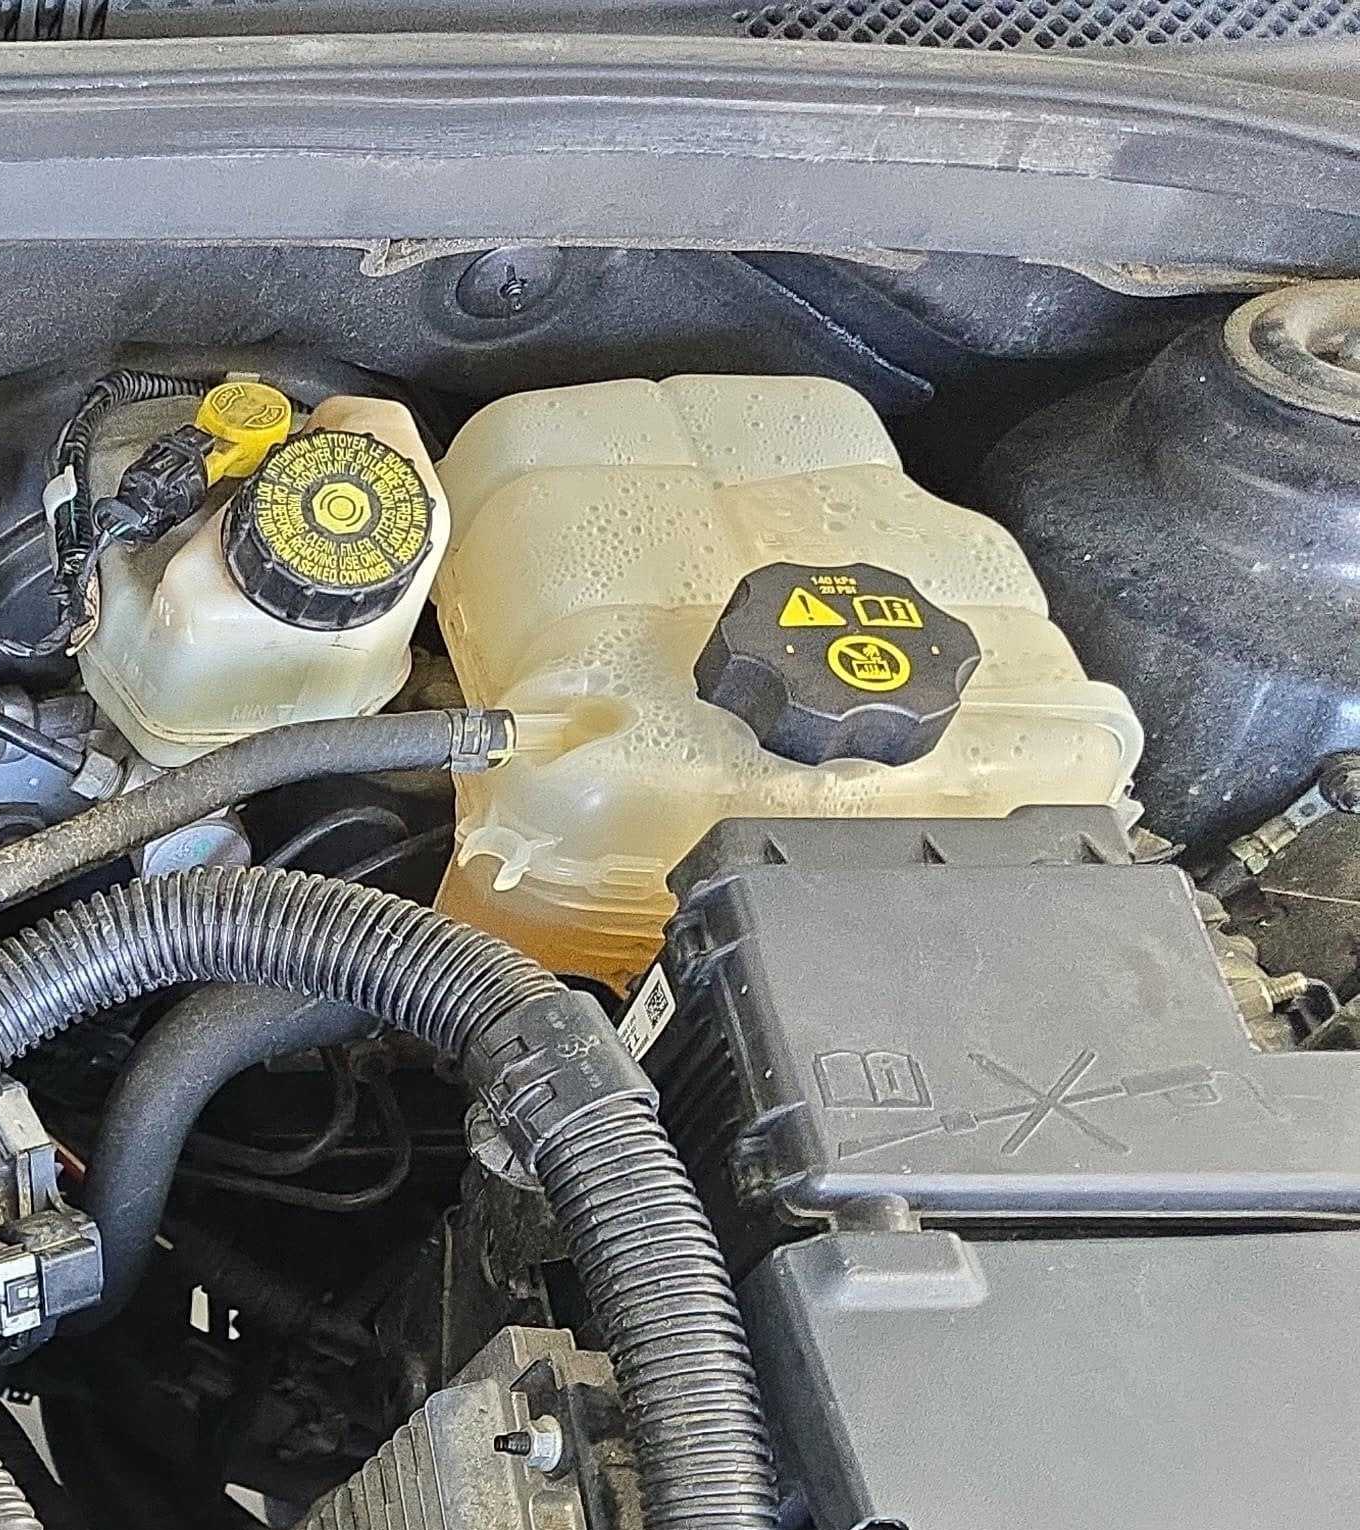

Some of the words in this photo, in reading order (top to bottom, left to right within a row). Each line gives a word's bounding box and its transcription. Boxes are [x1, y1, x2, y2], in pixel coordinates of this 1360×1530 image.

[285, 448, 332, 478] EMPLOYER
[334, 447, 354, 461] QUE
[356, 451, 372, 467] DU
[266, 438, 312, 481] ATTENTION
[312, 433, 367, 451] NETTOYER
[369, 443, 385, 458] LE
[384, 452, 421, 496] BOUCHON
[410, 497, 427, 527] AVANT
[292, 461, 346, 492] PROVENANT
[360, 467, 377, 485] UN
[372, 479, 395, 509] BIDON
[369, 459, 402, 489] LIQUIDE
[257, 481, 273, 501] DOT
[272, 485, 288, 504] CAP
[392, 487, 409, 501] DE
[257, 511, 278, 537] FLUID
[272, 505, 297, 540] BEFORE
[288, 493, 309, 534] WARNING
[305, 532, 336, 554] CLEAN
[340, 537, 375, 557] FILLER
[395, 502, 412, 529] FREIN
[268, 535, 295, 561] FROM
[387, 528, 406, 550] DOT
[288, 535, 337, 568] REMOVING
[290, 556, 301, 568] A
[340, 556, 360, 570] USE
[360, 550, 385, 567] ONLY
[297, 559, 337, 583] SEALED
[340, 560, 394, 585] CONTAINER
[810, 576, 833, 585] 140
[819, 586, 836, 594] 20
